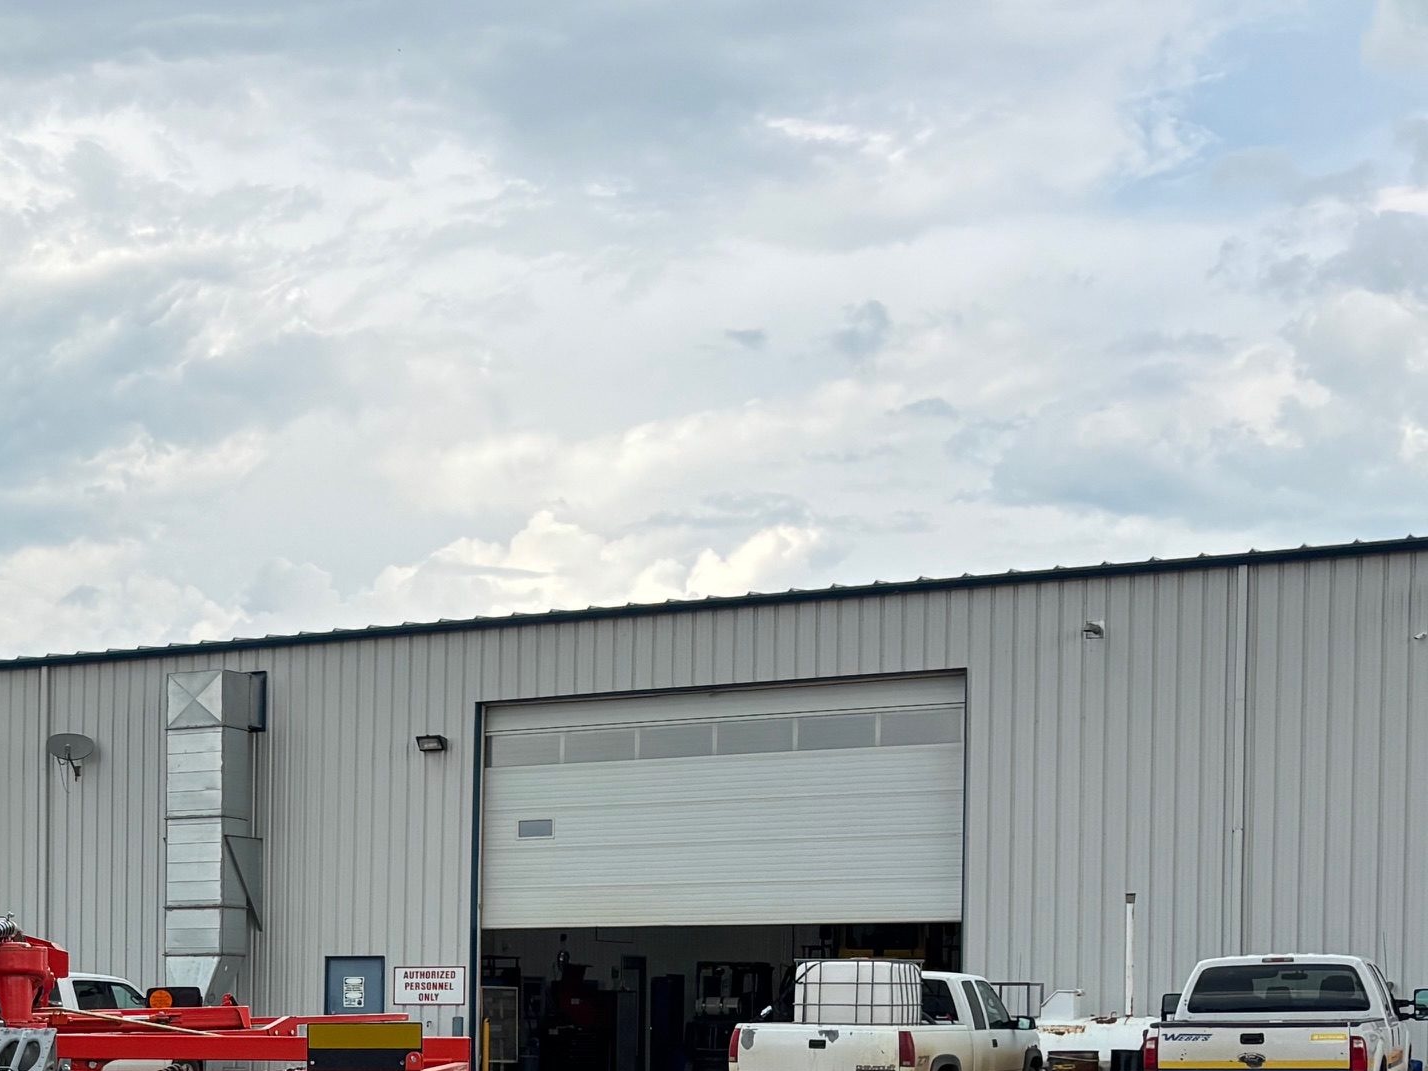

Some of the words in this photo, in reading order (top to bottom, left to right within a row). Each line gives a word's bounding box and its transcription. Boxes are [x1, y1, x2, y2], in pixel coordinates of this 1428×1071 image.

[403, 971, 456, 979] AUTHORIZED
[404, 982, 454, 990] PERSONNEL
[418, 993, 440, 1001] ONLY
